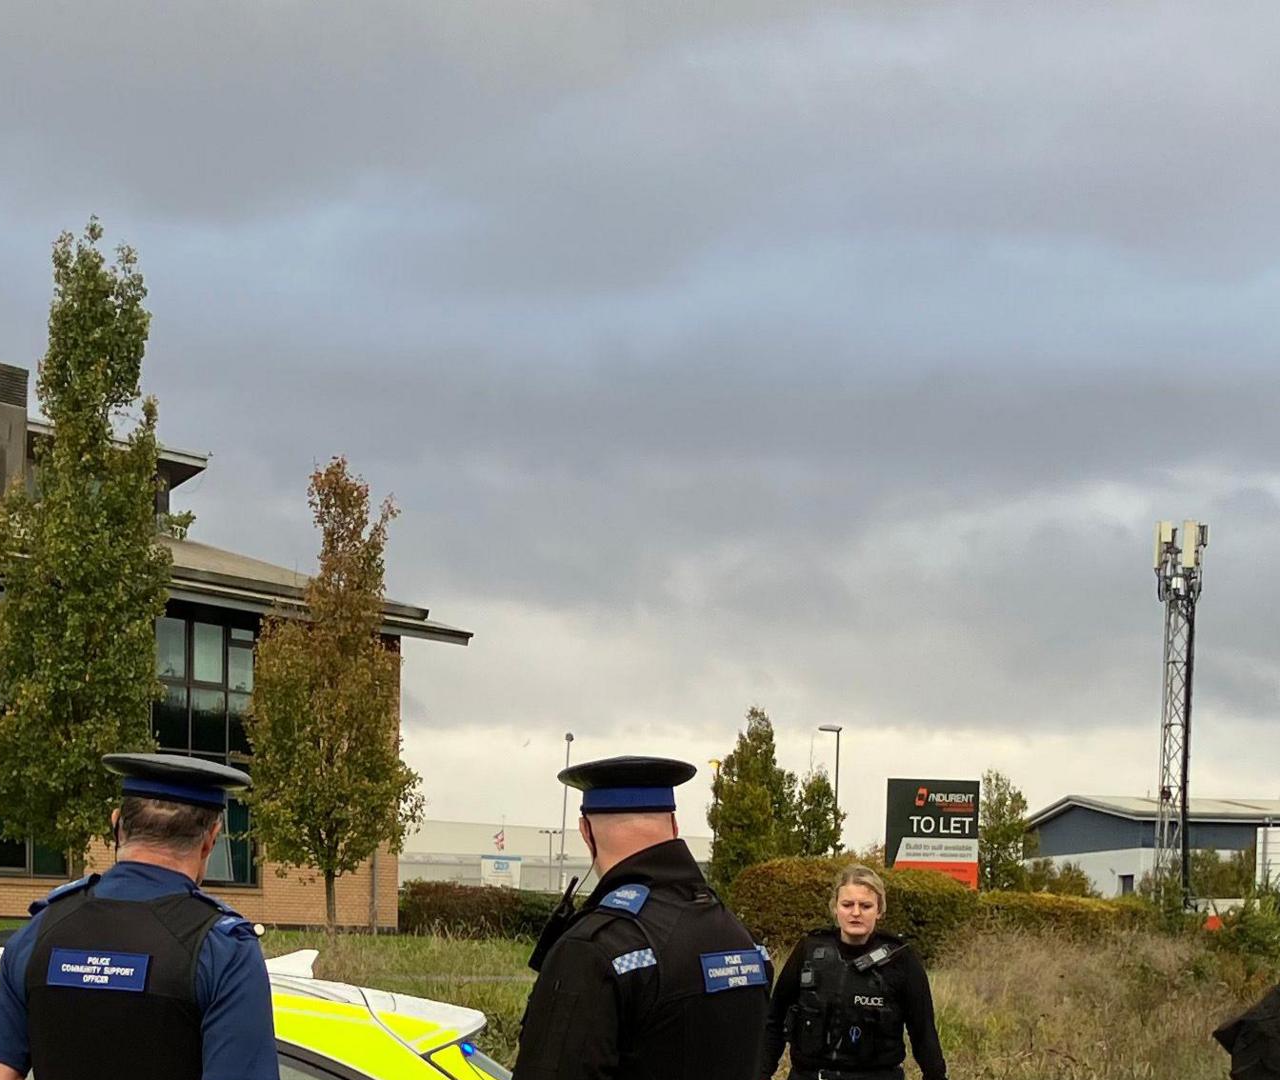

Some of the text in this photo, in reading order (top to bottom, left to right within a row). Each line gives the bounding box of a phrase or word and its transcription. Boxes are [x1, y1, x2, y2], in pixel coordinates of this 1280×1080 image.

[909, 816, 974, 834] TO LET
[87, 957, 111, 966] POLICE
[724, 954, 742, 965] POLICE
[61, 964, 134, 976] COMMUNITY SUPPORT
[83, 975, 109, 984] OFFICER
[854, 995, 884, 1007] POLICE
